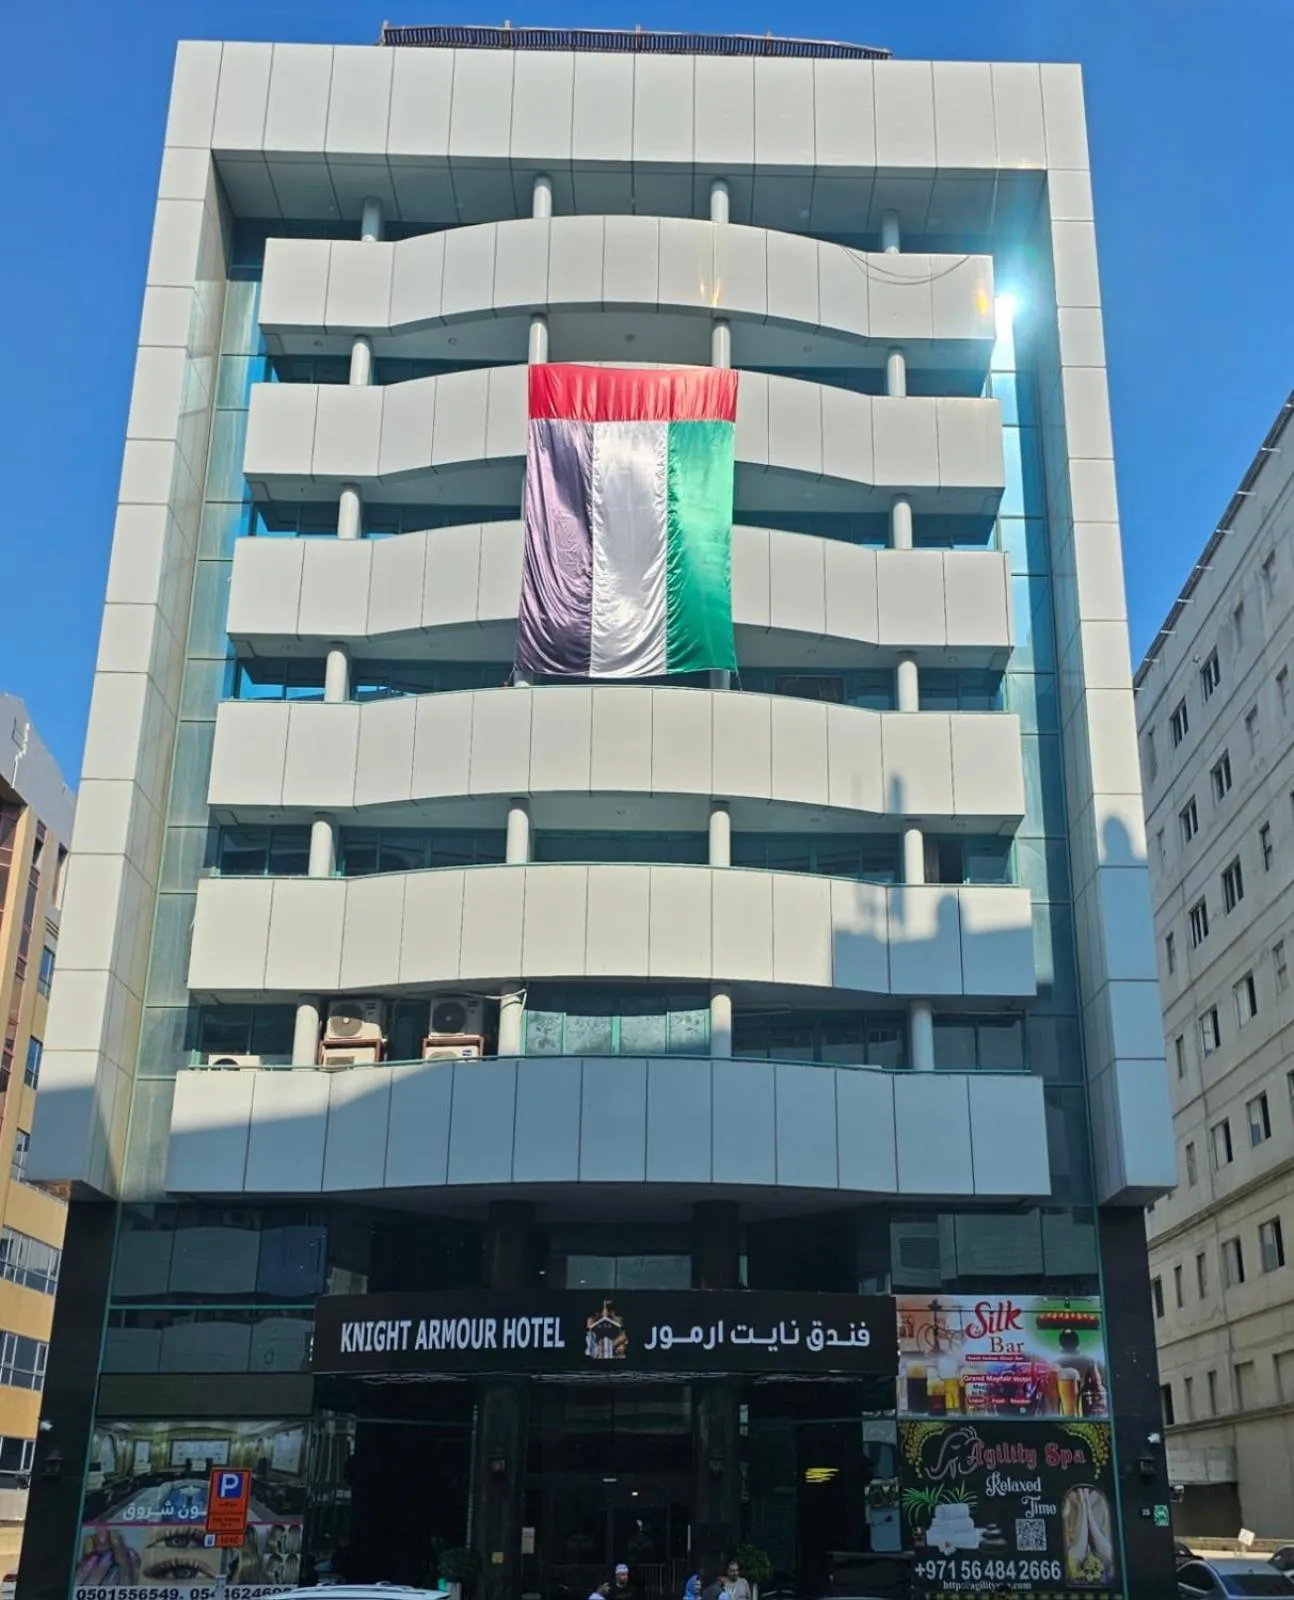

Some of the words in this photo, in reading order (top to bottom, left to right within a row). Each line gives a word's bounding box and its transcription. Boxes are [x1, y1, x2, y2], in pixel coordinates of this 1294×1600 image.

[965, 1300, 1024, 1339] Silk
[341, 1320, 411, 1352] KNIGHT
[415, 1318, 497, 1350] ARMOUR
[503, 1317, 565, 1348] HOTEL
[644, 1320, 724, 1350] ارمور
[730, 1320, 799, 1352] نايت
[806, 1321, 870, 1351] فندق
[991, 1336, 1024, 1353] Bar
[966, 1442, 1037, 1470] Agility
[1044, 1442, 1086, 1470] Spa
[220, 1473, 239, 1497] P
[986, 1471, 1042, 1497] Relaxed
[123, 1500, 174, 1520] شروق
[915, 1560, 956, 1579] +971
[961, 1560, 981, 1580] 56
[984, 1560, 1016, 1580] 484
[1019, 1560, 1061, 1580] 2666
